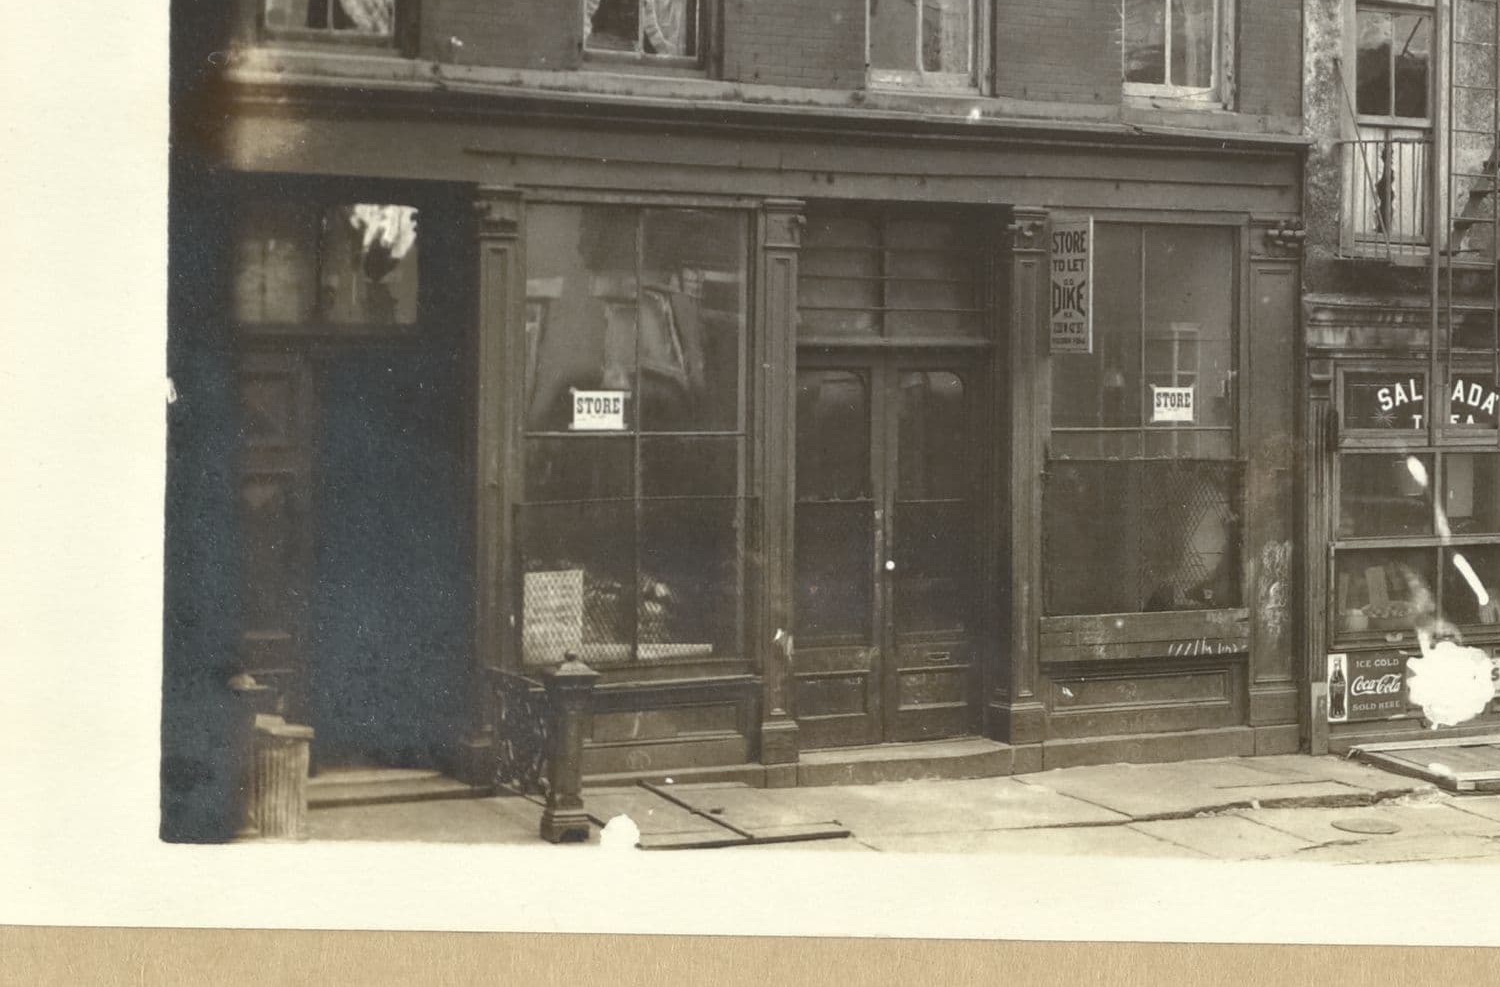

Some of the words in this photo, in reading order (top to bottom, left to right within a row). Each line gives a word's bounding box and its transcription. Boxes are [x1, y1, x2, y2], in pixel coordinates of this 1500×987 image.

[1052, 230, 1087, 253] STORE
[1053, 259, 1065, 272] TO
[1067, 258, 1086, 272] LET
[1052, 279, 1086, 318] DIKE
[576, 396, 621, 414] STORE
[1155, 392, 1191, 408] STORE
[1356, 659, 1372, 668] ICE
[1374, 658, 1400, 667] COLD
[1351, 672, 1402, 696] Coca-Cola
[1352, 702, 1376, 711] SOLD
[1378, 700, 1400, 709] HERE
